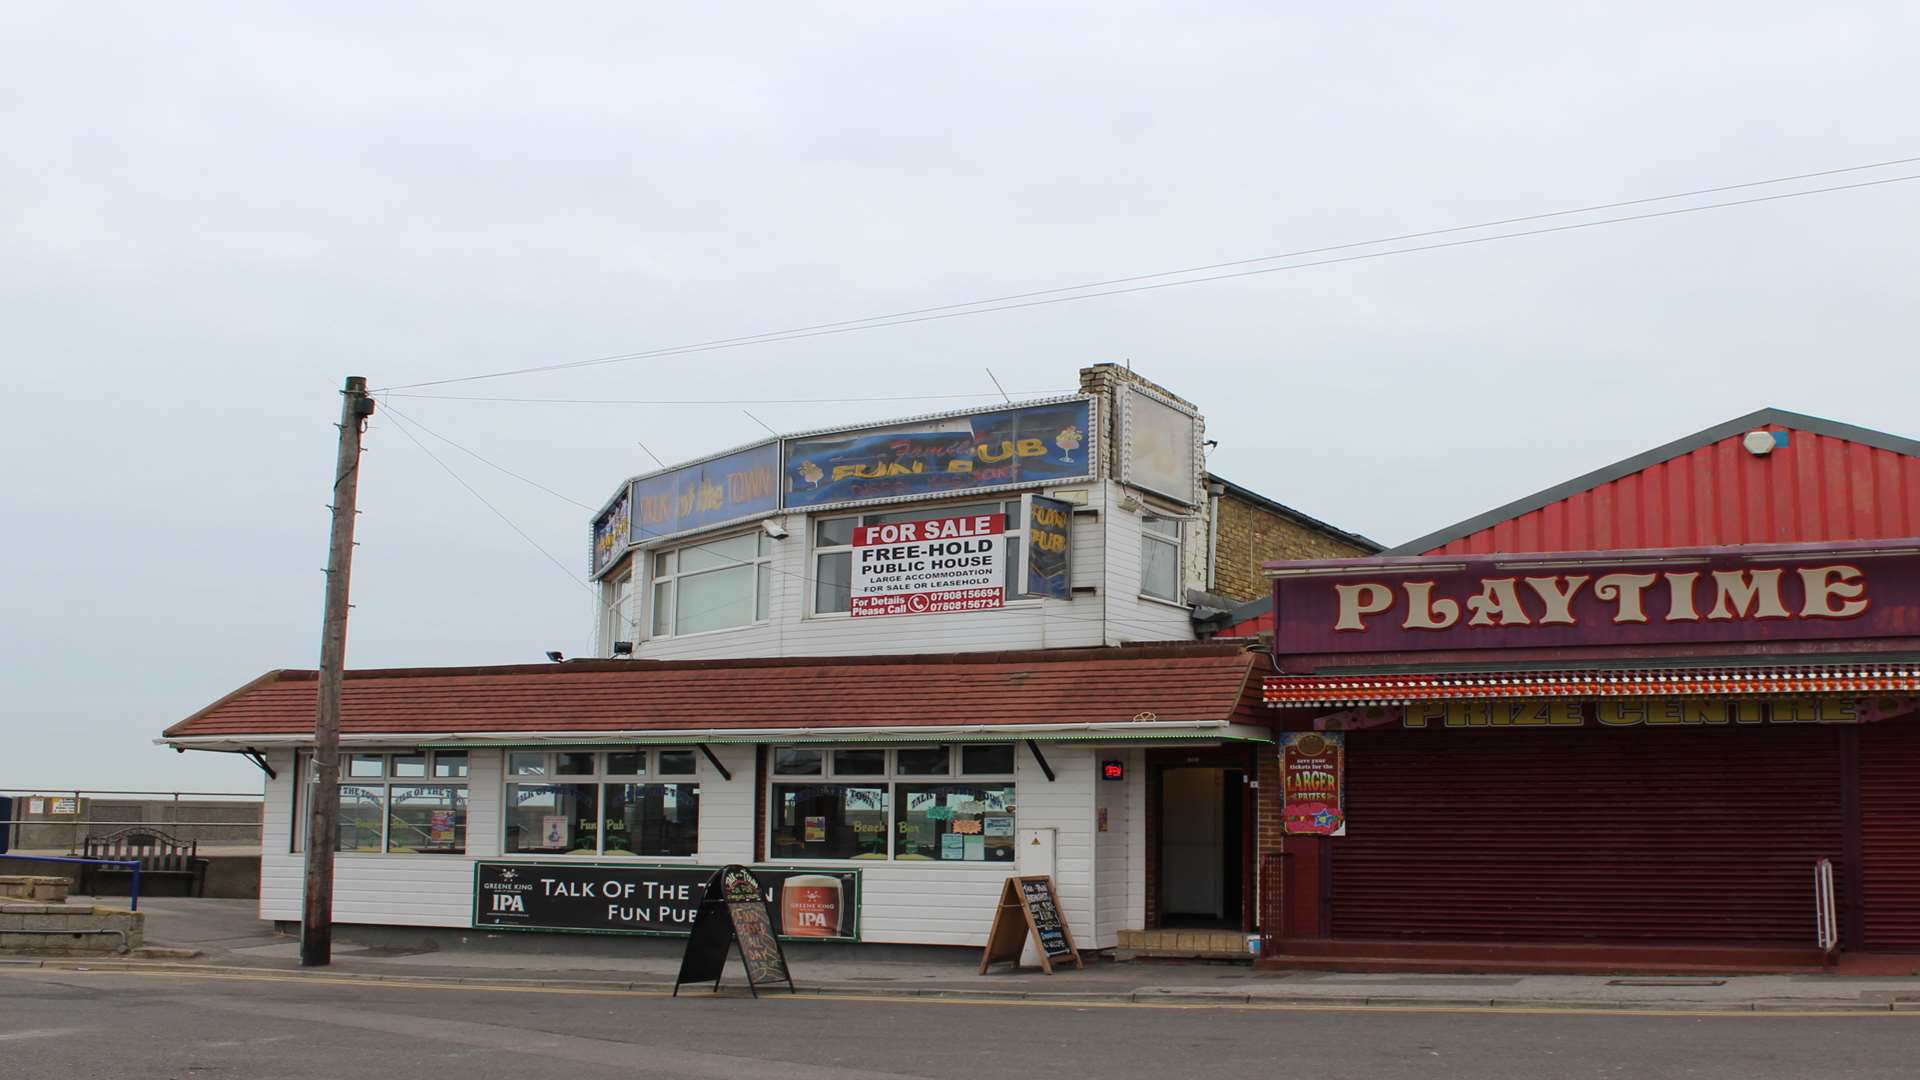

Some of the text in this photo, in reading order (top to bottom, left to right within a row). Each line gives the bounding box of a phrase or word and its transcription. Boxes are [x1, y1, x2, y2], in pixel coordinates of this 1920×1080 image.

[866, 516, 991, 545] FOR SALE
[1031, 528, 1066, 553] PUB
[862, 539, 993, 562] FREE-HOLD
[862, 555, 993, 575] PUBLIC HOUSE
[870, 568, 993, 584] LARGE ACCOMMODATION
[887, 584, 911, 592] SALE
[931, 577, 990, 588] LEASEHOLD
[853, 595, 905, 607] For Details
[1334, 564, 1872, 632] PLAYTIME
[852, 602, 907, 616] Please Call
[1286, 770, 1336, 792] LARGER
[343, 786, 360, 796] THE
[427, 786, 444, 796] THE
[579, 818, 625, 831] Fun Pub
[853, 820, 920, 833] Beach Bar
[483, 882, 512, 890] GREENE
[513, 883, 533, 891] KING
[540, 878, 596, 897] TALK
[602, 880, 636, 899] OF
[643, 881, 689, 900] THE
[492, 894, 525, 912] IPA
[607, 904, 650, 921] FUN
[798, 911, 827, 928] IPA
